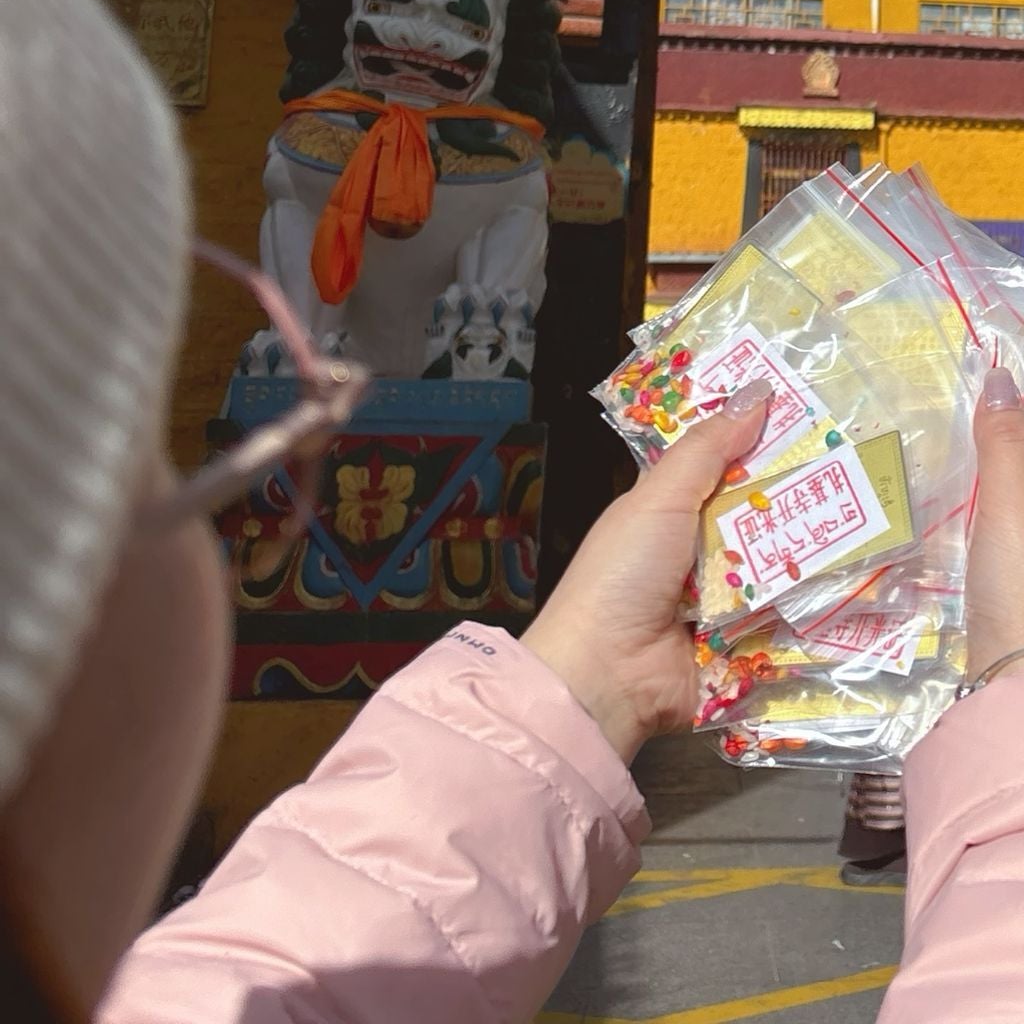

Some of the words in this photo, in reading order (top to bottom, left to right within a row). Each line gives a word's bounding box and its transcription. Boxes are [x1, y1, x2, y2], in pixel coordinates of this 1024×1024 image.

[739, 466, 845, 546] 扎基寺开光证
